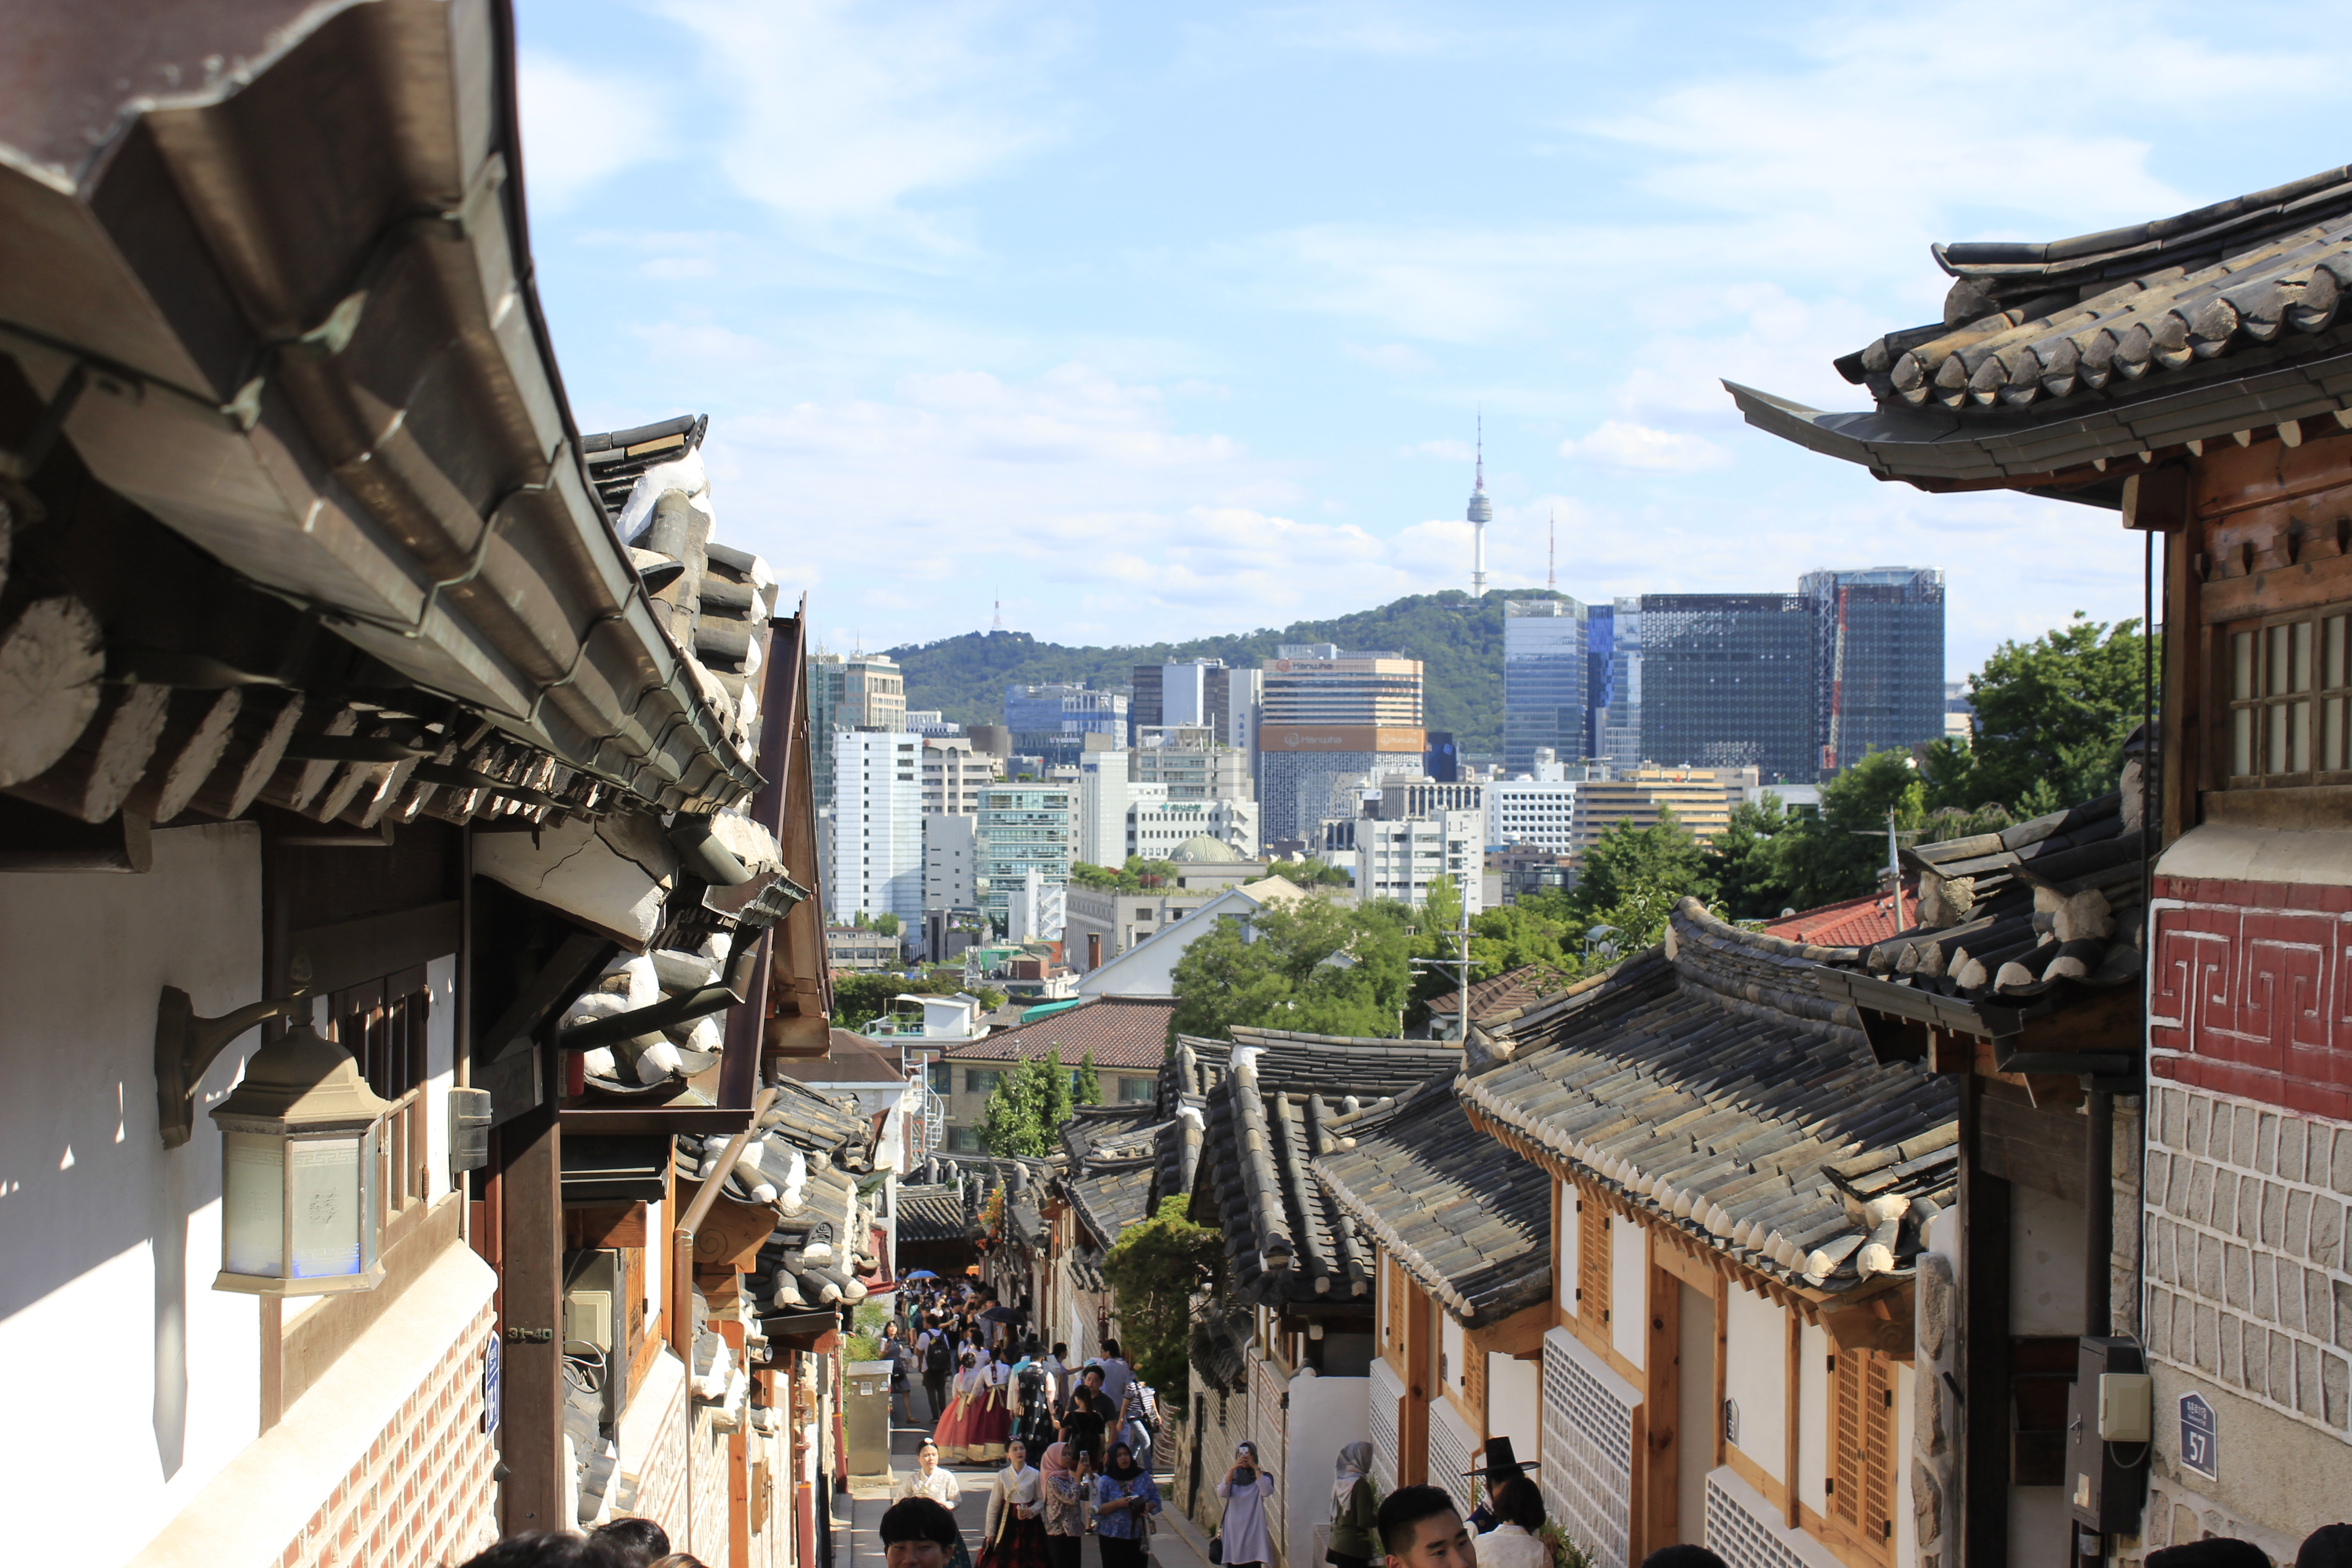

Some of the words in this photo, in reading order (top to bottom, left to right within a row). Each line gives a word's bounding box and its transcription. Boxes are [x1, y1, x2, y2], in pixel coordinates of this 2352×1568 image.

[1294, 662, 1333, 670] Hanwha
[508, 1328, 553, 1340] 31-40
[488, 1380, 497, 1427] 58-1
[2190, 1431, 2206, 1464] 57
